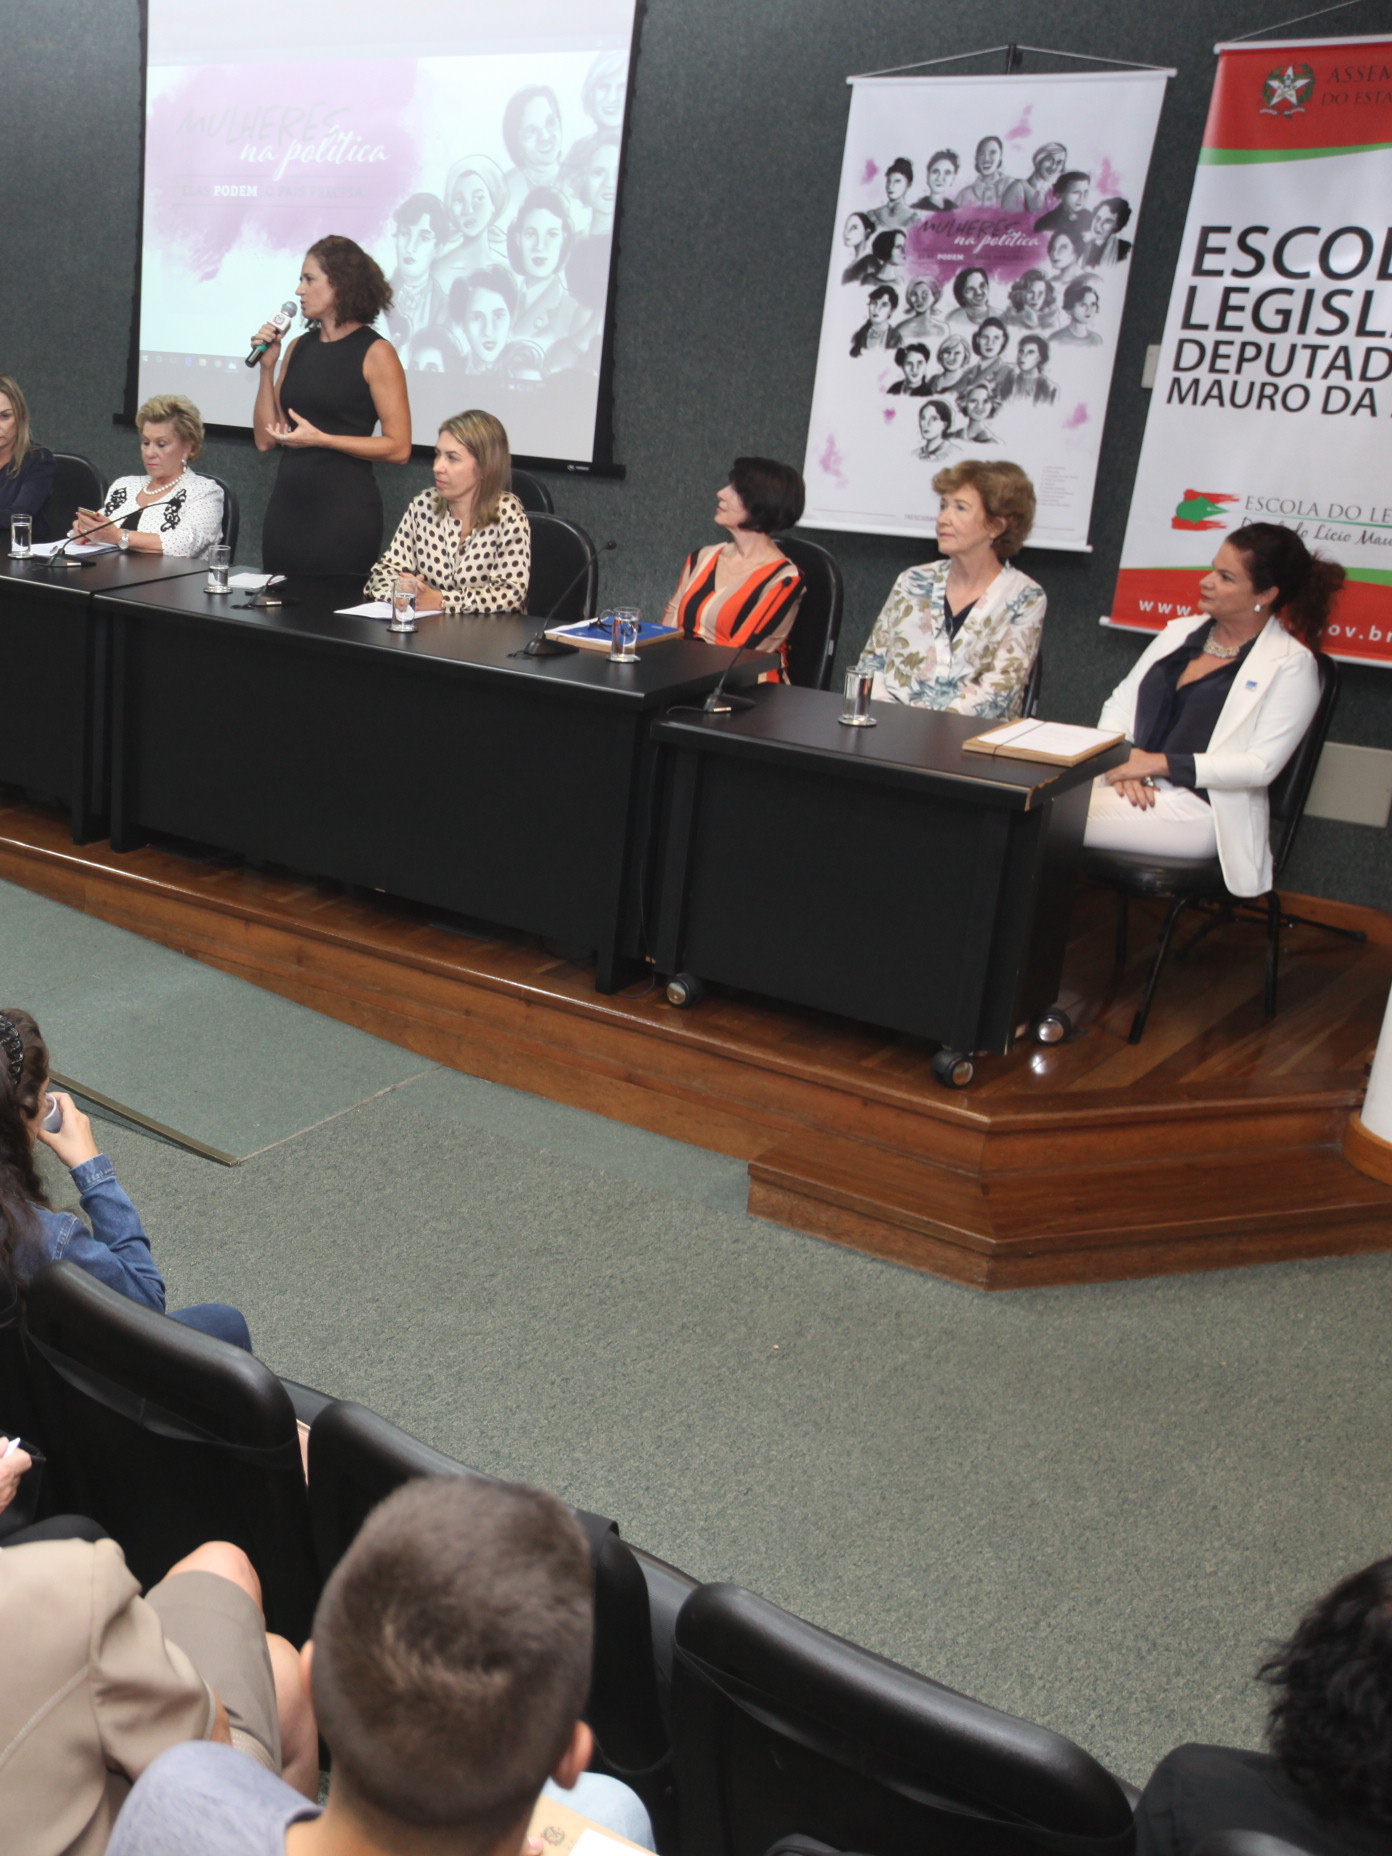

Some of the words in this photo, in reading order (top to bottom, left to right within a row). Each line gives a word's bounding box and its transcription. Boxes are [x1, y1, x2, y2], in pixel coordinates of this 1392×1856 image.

[1322, 92, 1349, 106] DO
[176, 101, 352, 147] MULHERES
[239, 142, 277, 163] na
[272, 124, 391, 182] política
[953, 235, 975, 246] na
[1180, 285, 1392, 337] LEGISL
[1172, 338, 1392, 383] DEPUTAD
[1166, 376, 1311, 413] MAURO
[1321, 385, 1378, 418] DA
[1245, 495, 1319, 517] ESCOLA
[1328, 503, 1362, 521] DO
[1370, 507, 1392, 524] LE
